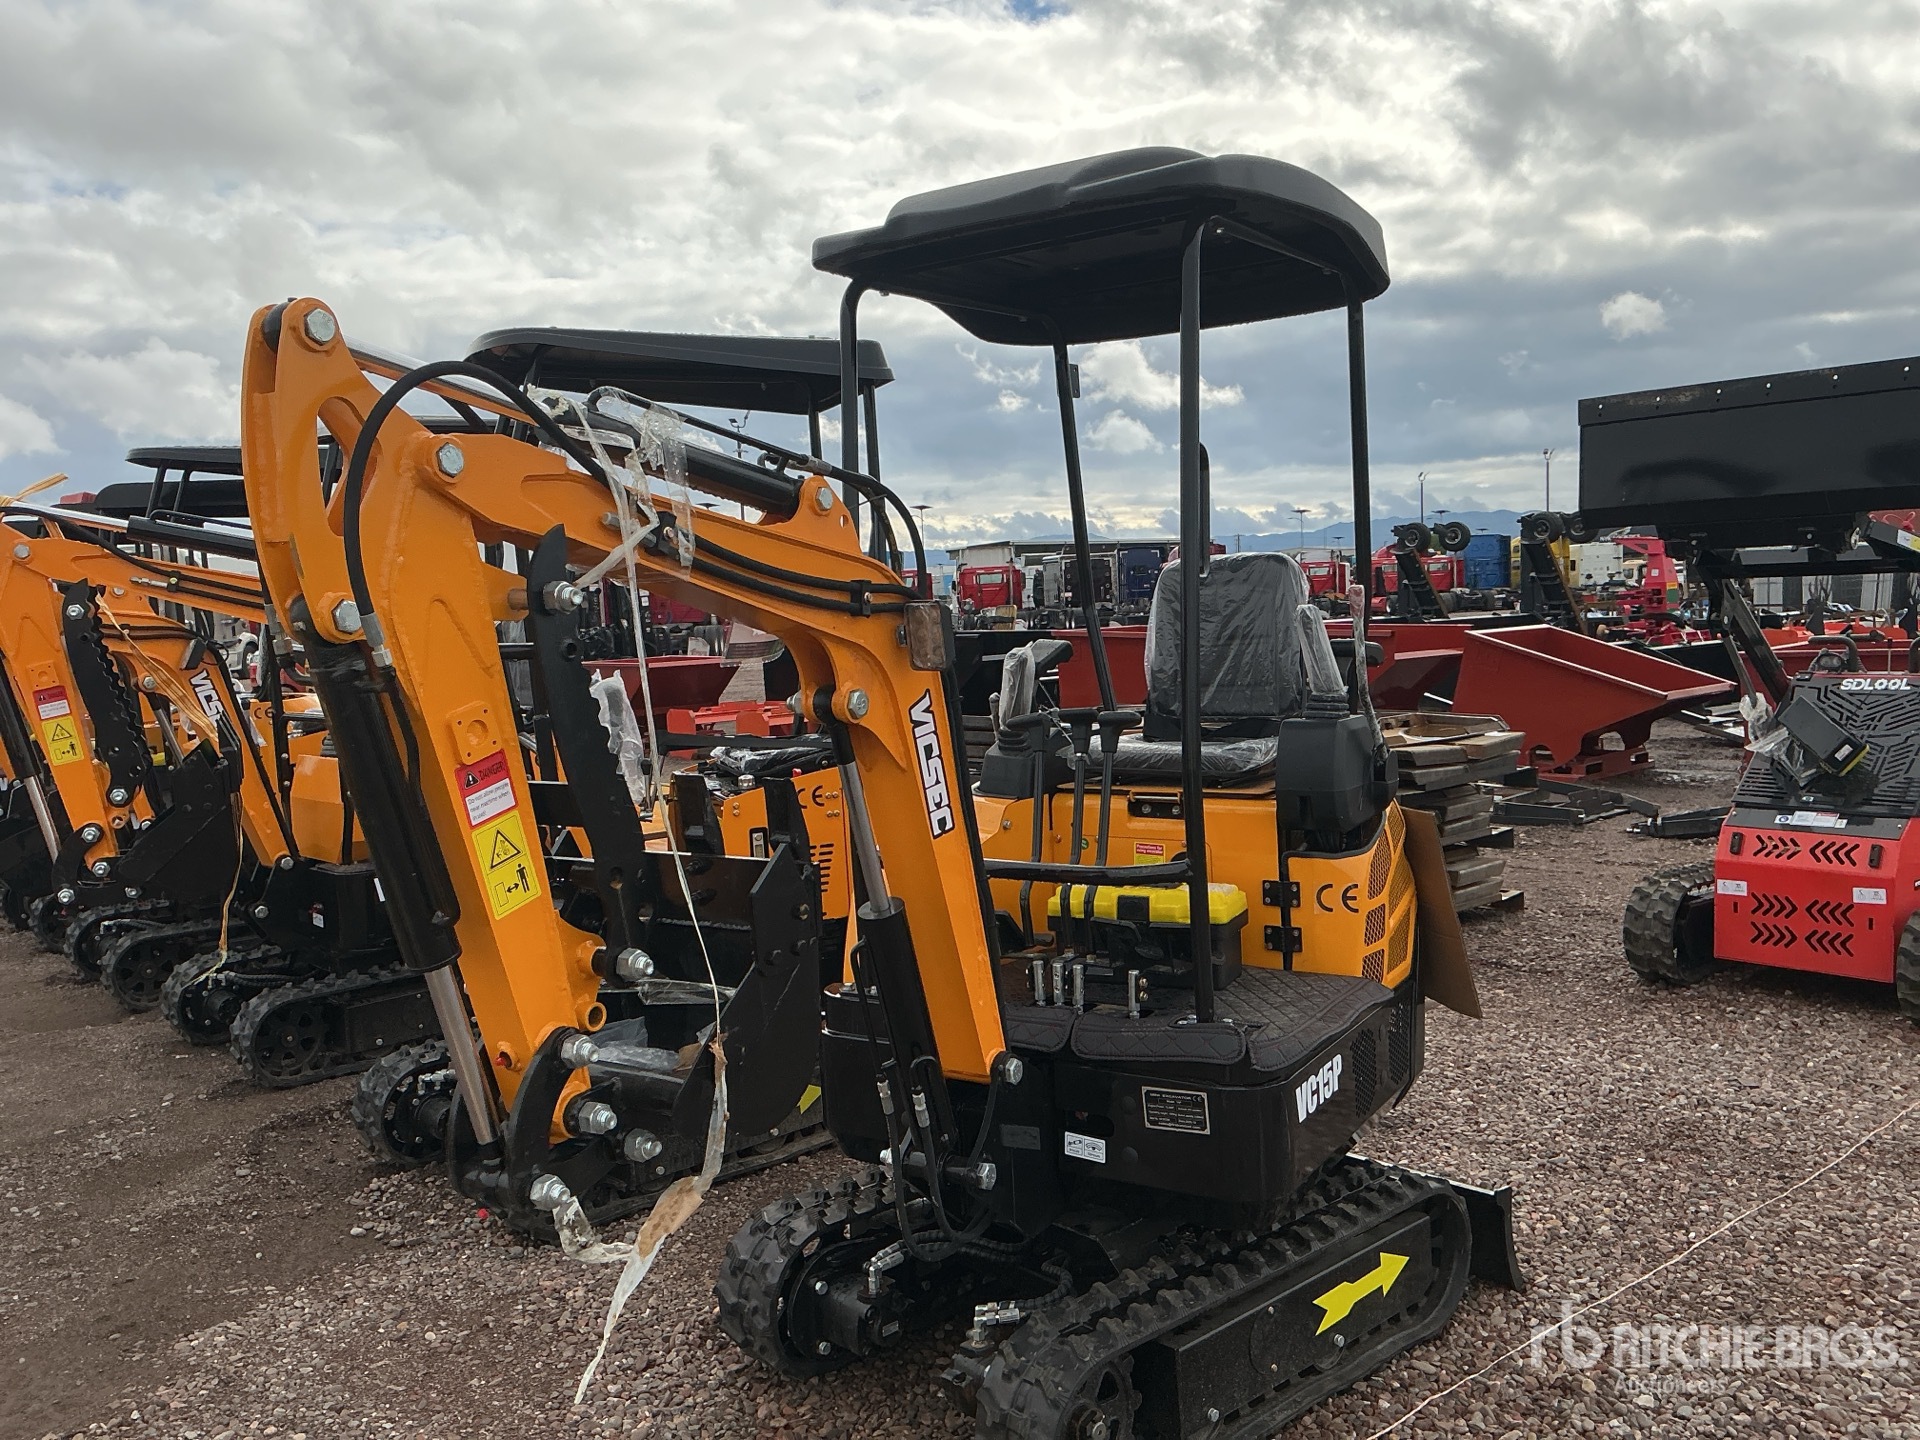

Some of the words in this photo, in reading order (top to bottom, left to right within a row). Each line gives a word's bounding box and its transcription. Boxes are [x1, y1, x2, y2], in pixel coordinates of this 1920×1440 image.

[908, 689, 955, 839] VICSEC
[1316, 884, 1359, 913] CE
[1295, 1053, 1343, 1124] VC15P
